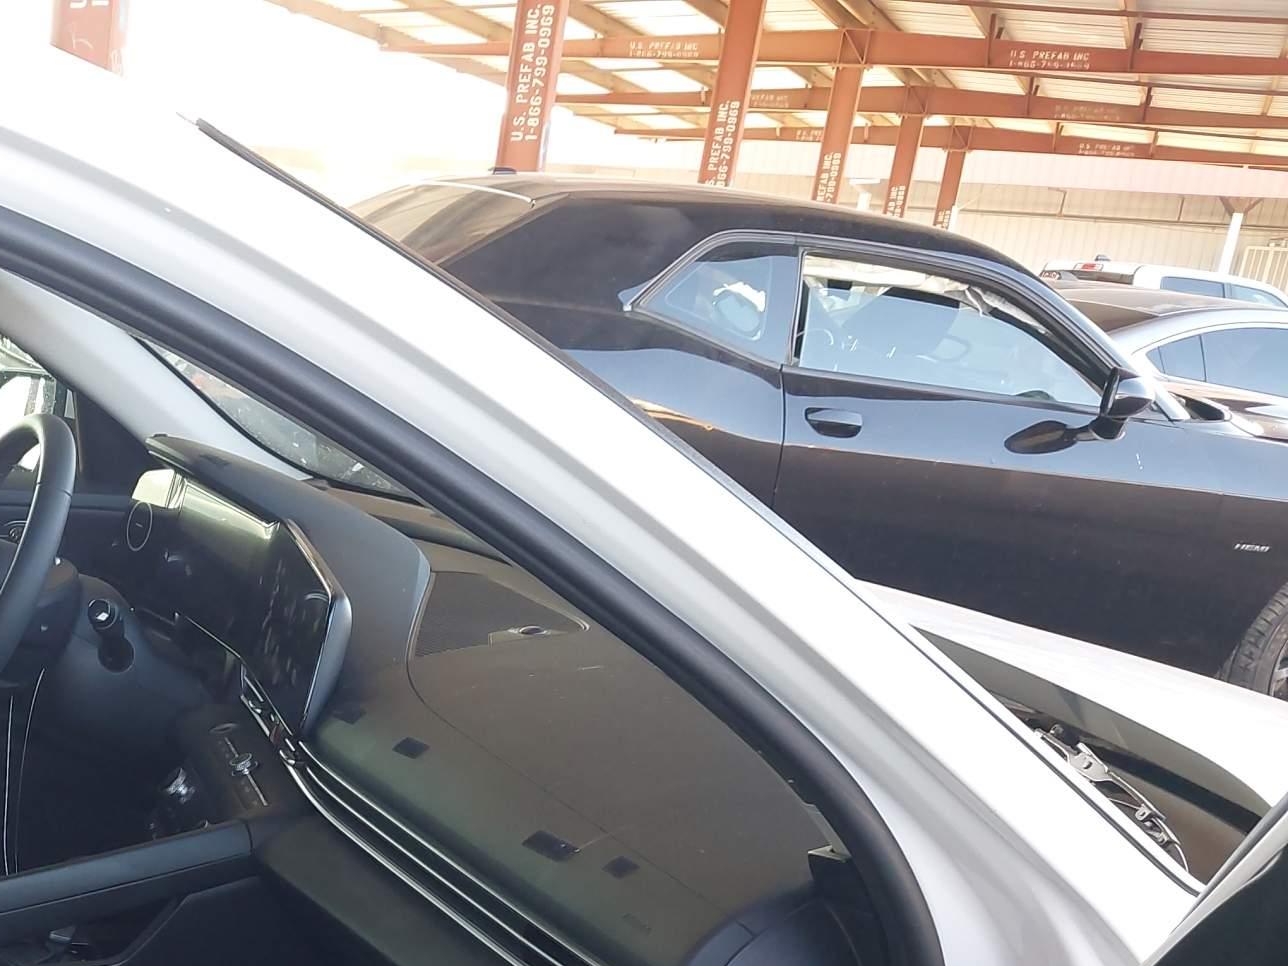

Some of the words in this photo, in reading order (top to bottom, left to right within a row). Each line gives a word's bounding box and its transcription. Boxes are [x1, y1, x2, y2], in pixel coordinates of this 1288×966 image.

[525, 3, 542, 35] INC.
[515, 42, 536, 104] PREFAB
[525, 4, 555, 141] 1-866-799-0969
[511, 111, 527, 142] U.S.
[707, 126, 725, 171] PREFAB
